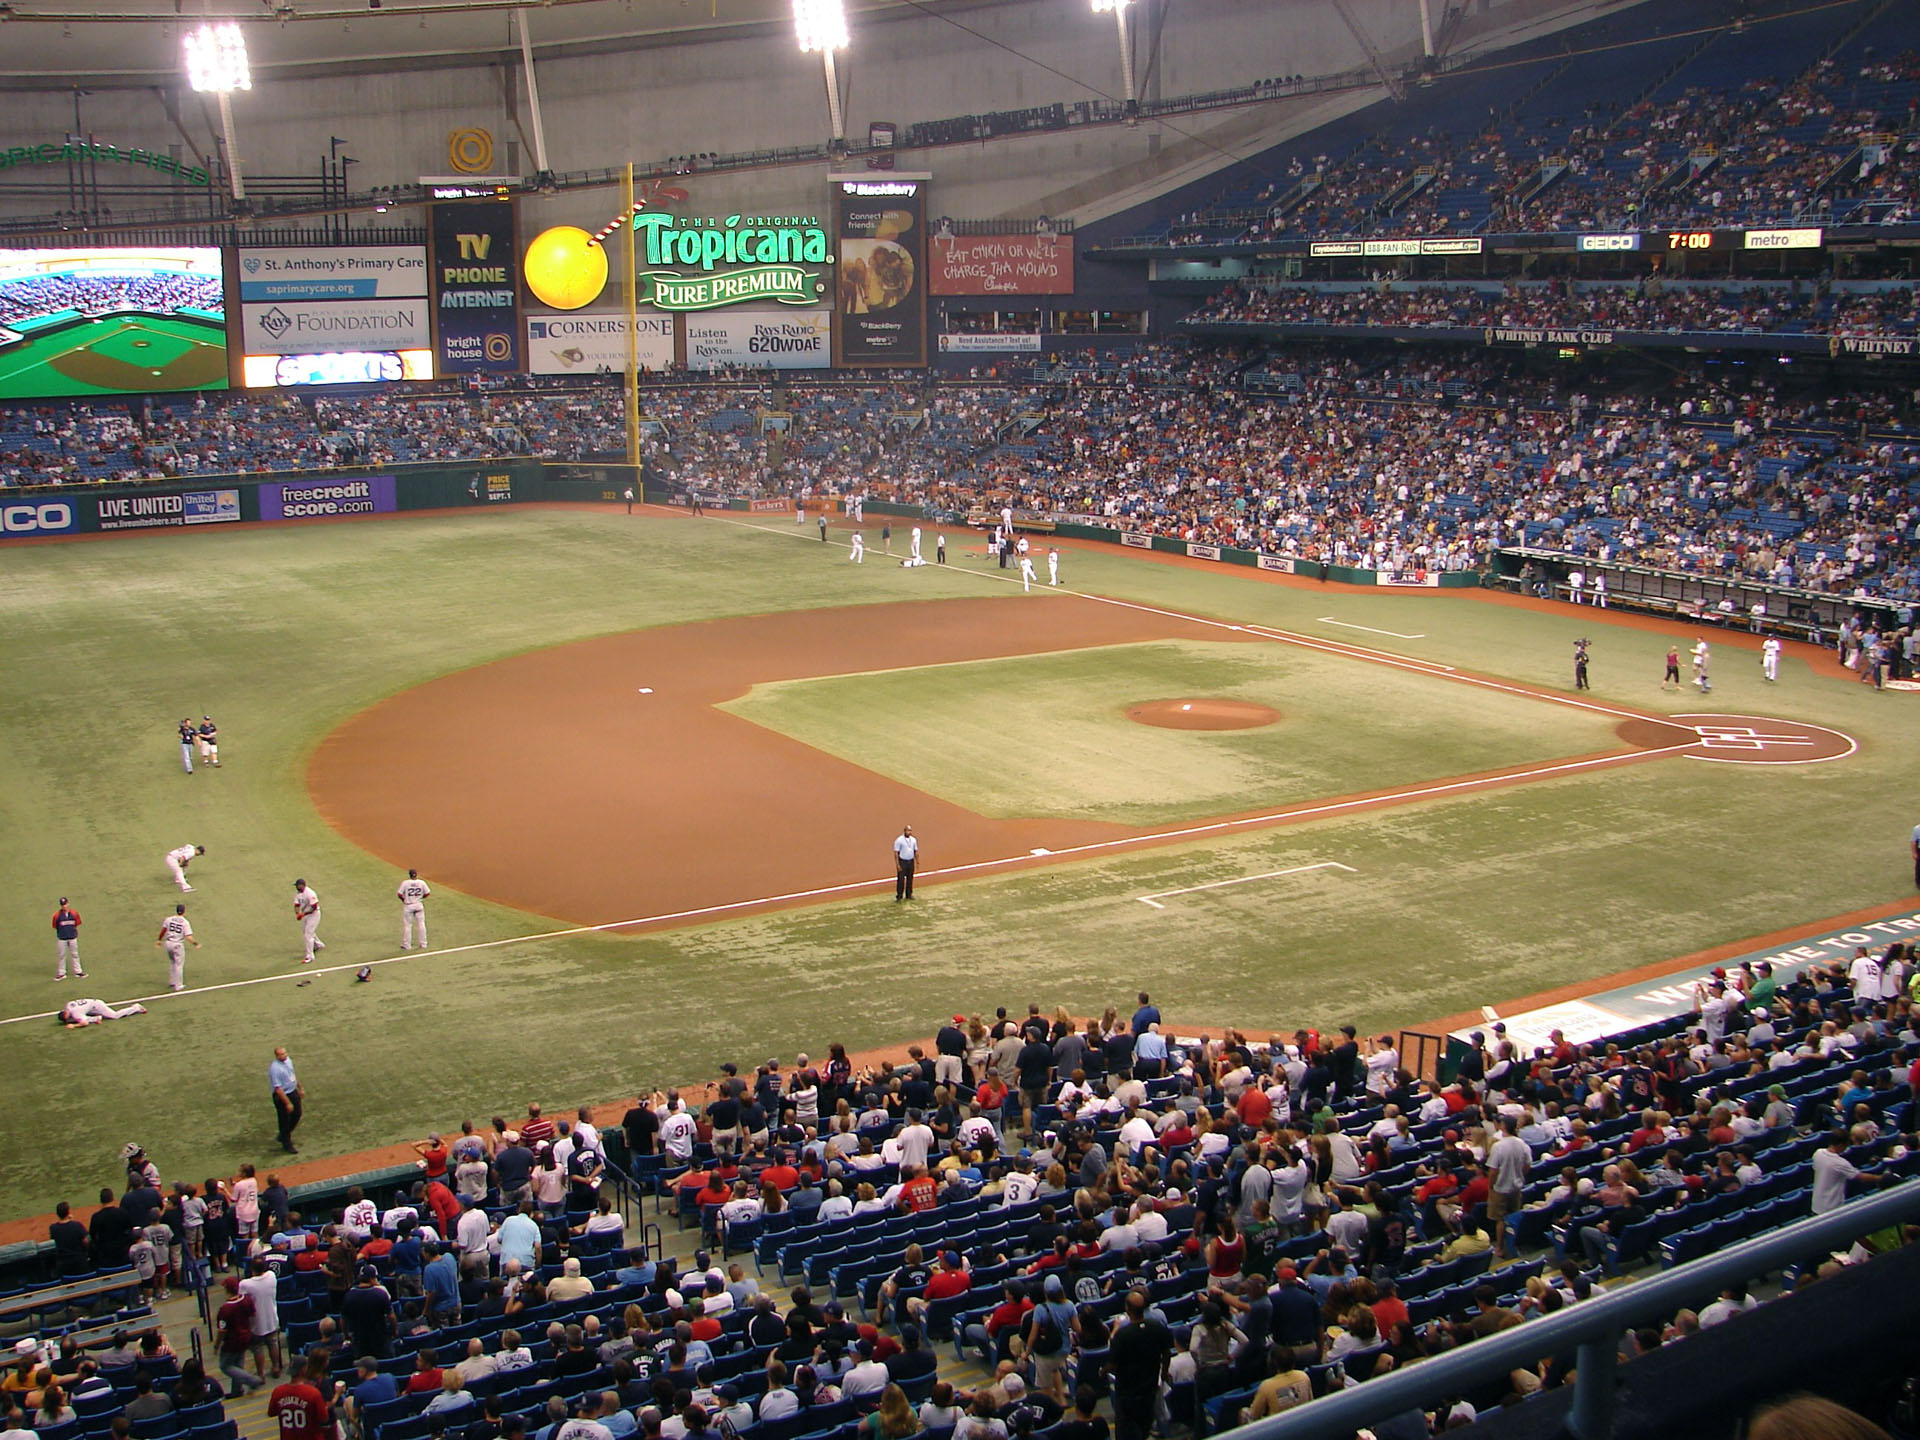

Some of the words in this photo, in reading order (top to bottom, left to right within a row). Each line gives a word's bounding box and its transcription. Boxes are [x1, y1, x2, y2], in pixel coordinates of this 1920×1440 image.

[130, 149, 210, 186] FIELD
[680, 217, 716, 226] THE
[746, 217, 818, 226] ORIGINAL
[456, 234, 491, 260] TV
[633, 213, 826, 271] Tropicana
[1582, 236, 1633, 249] GEICO
[1668, 233, 1712, 248] 7:00
[946, 251, 969, 263] EAT
[972, 244, 1005, 259] CHIKIN
[1009, 245, 1023, 257] OR
[265, 260, 281, 270] St.
[285, 258, 344, 272] Anthony's
[348, 258, 394, 271] Primary
[397, 257, 424, 268] Care
[944, 265, 987, 279] CHARGE
[991, 261, 1012, 275] THA
[1016, 262, 1058, 277] MOUND
[444, 267, 507, 283] PHONE
[266, 284, 354, 295] saprimarycare.org
[656, 282, 708, 304] PURE
[712, 272, 803, 300] PREMIUM
[441, 290, 514, 308] INTERNET
[296, 310, 414, 331] FOUNDATION
[548, 320, 672, 338] CORNERSTONE
[689, 328, 728, 338] Listen
[1495, 329, 1545, 342] WHITNEY
[1547, 331, 1578, 343] BANK
[1581, 332, 1612, 343] CLUB
[446, 336, 482, 349] bright
[748, 336, 821, 353] 620WDAE
[1843, 339, 1912, 353] WHITNEY
[447, 349, 482, 358] house
[488, 475, 510, 484] PRICE
[185, 494, 215, 504] United
[282, 482, 369, 502] freecredit
[99, 498, 129, 518] LIVE
[132, 495, 183, 516] UNITED
[197, 504, 215, 513] Way
[283, 500, 373, 517] score.com
[407, 887, 422, 897] 22
[1816, 933, 1873, 948] TO
[674, 1123, 689, 1138] 31
[1009, 1184, 1020, 1200] 3
[355, 1211, 374, 1228] 46
[1263, 1239, 1275, 1256] 5
[139, 1253, 147, 1264] 2
[639, 1364, 648, 1378] 5
[281, 1408, 306, 1428] 20
